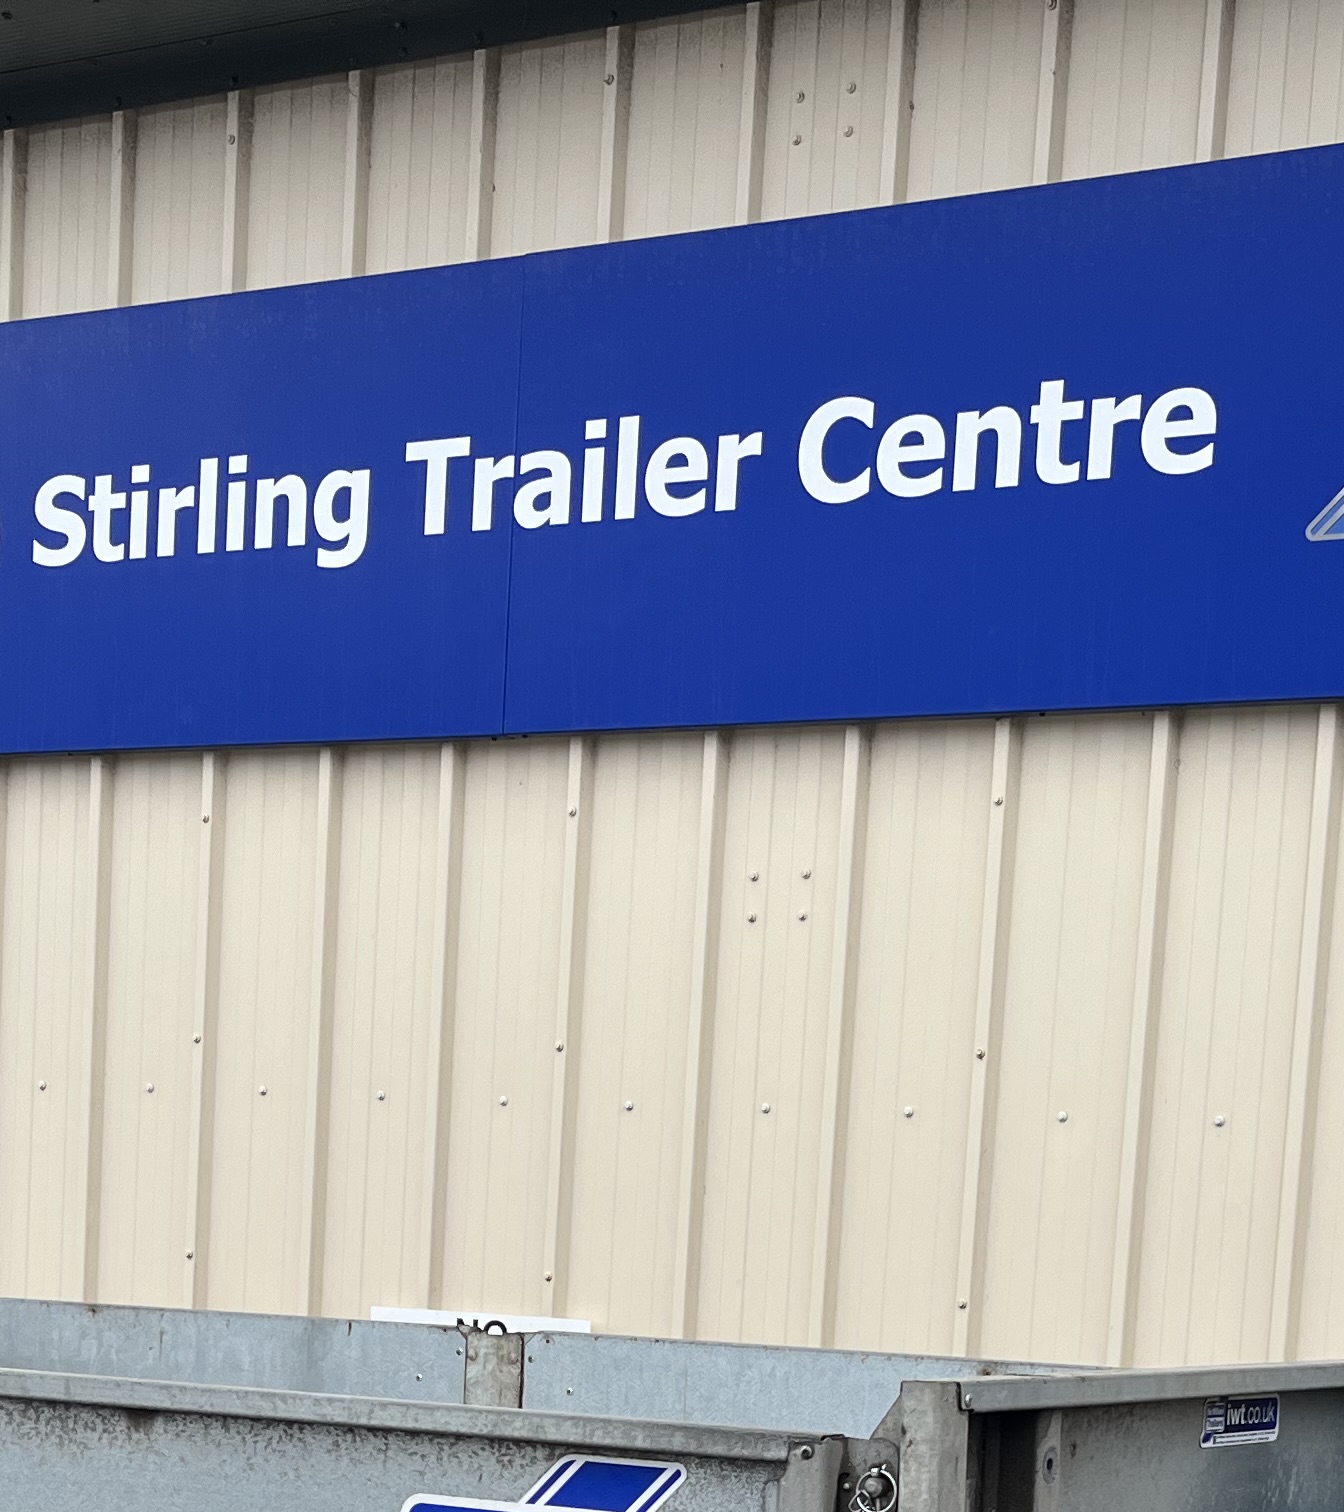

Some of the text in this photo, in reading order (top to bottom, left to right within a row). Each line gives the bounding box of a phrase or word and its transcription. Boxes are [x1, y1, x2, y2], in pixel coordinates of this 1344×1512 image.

[32, 379, 1217, 569] Stirling Trailer Centre
[1227, 1402, 1276, 1426] iwt.co.uk
